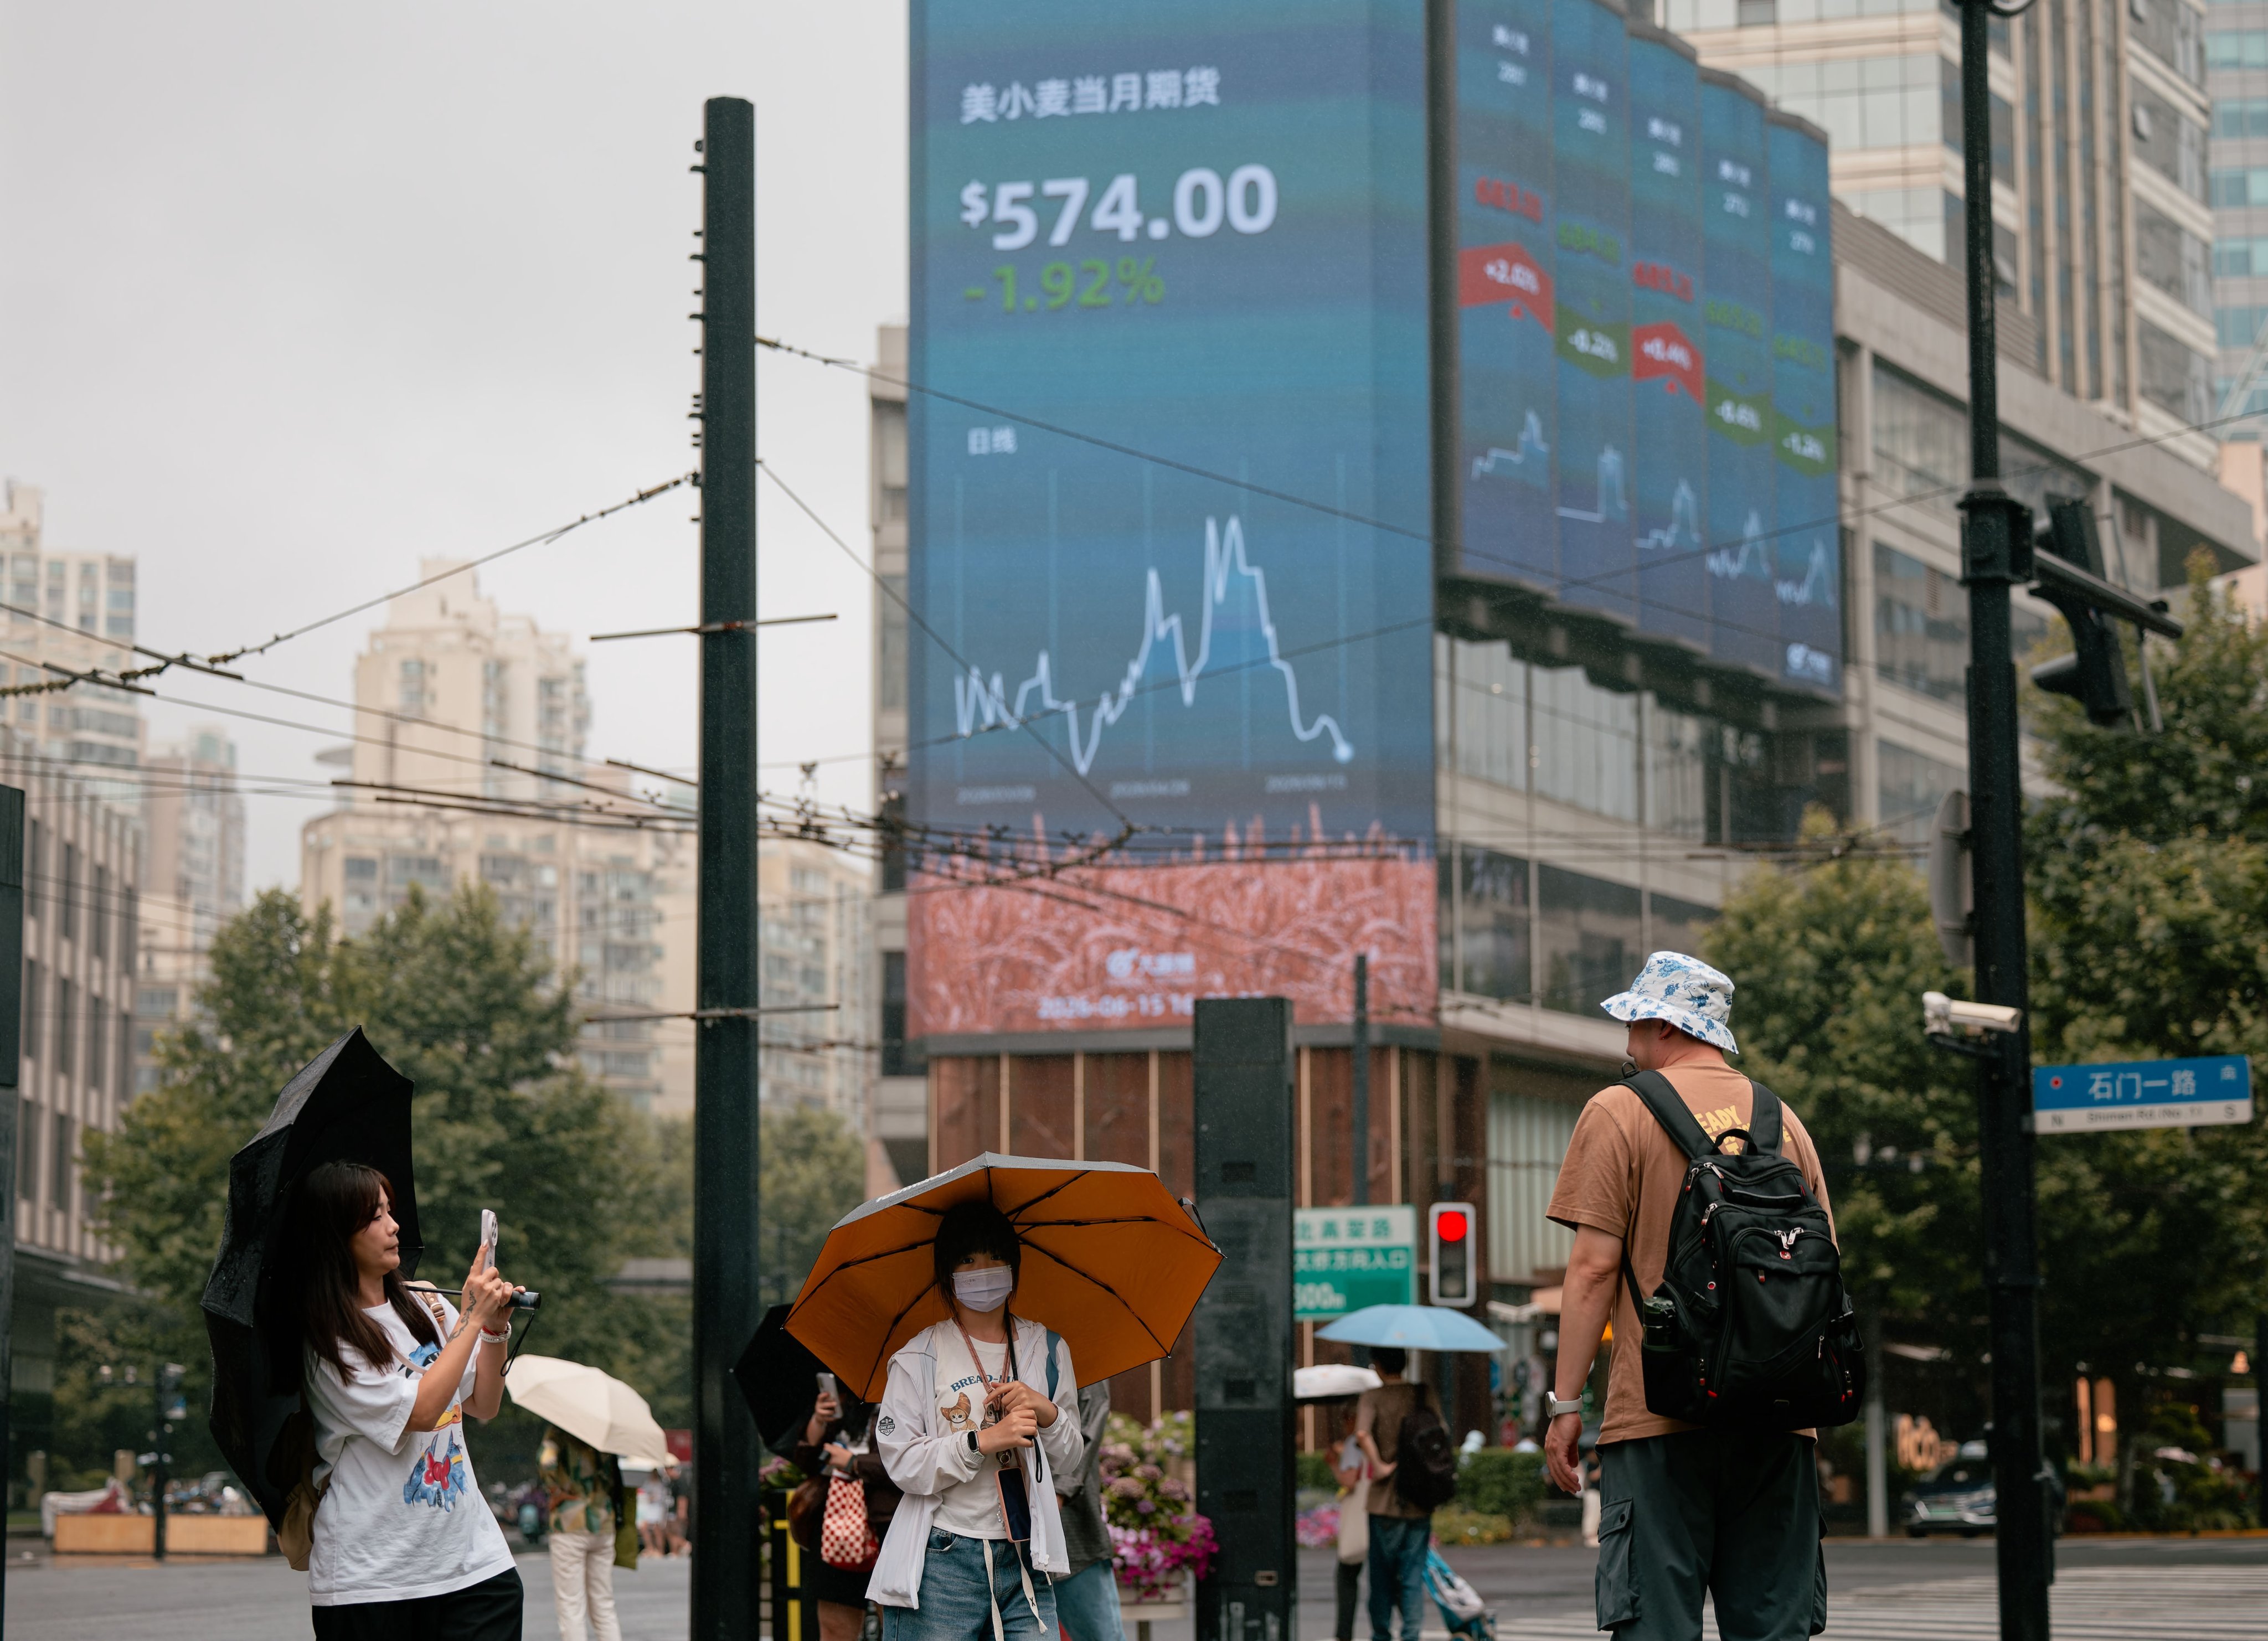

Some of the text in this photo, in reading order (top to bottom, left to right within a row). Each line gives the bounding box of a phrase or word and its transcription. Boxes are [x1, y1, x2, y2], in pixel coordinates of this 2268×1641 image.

[961, 67, 1219, 124] 美小麦当月期货
[961, 164, 1277, 250] $574.00
[965, 256, 1166, 313] -1.92%
[968, 426, 1017, 454] 日线
[2088, 1070, 2196, 1100] 石门一路
[2220, 1065, 2237, 1081] 南
[2087, 1109, 2133, 1124] Shimen
[2224, 1104, 2236, 1118] S
